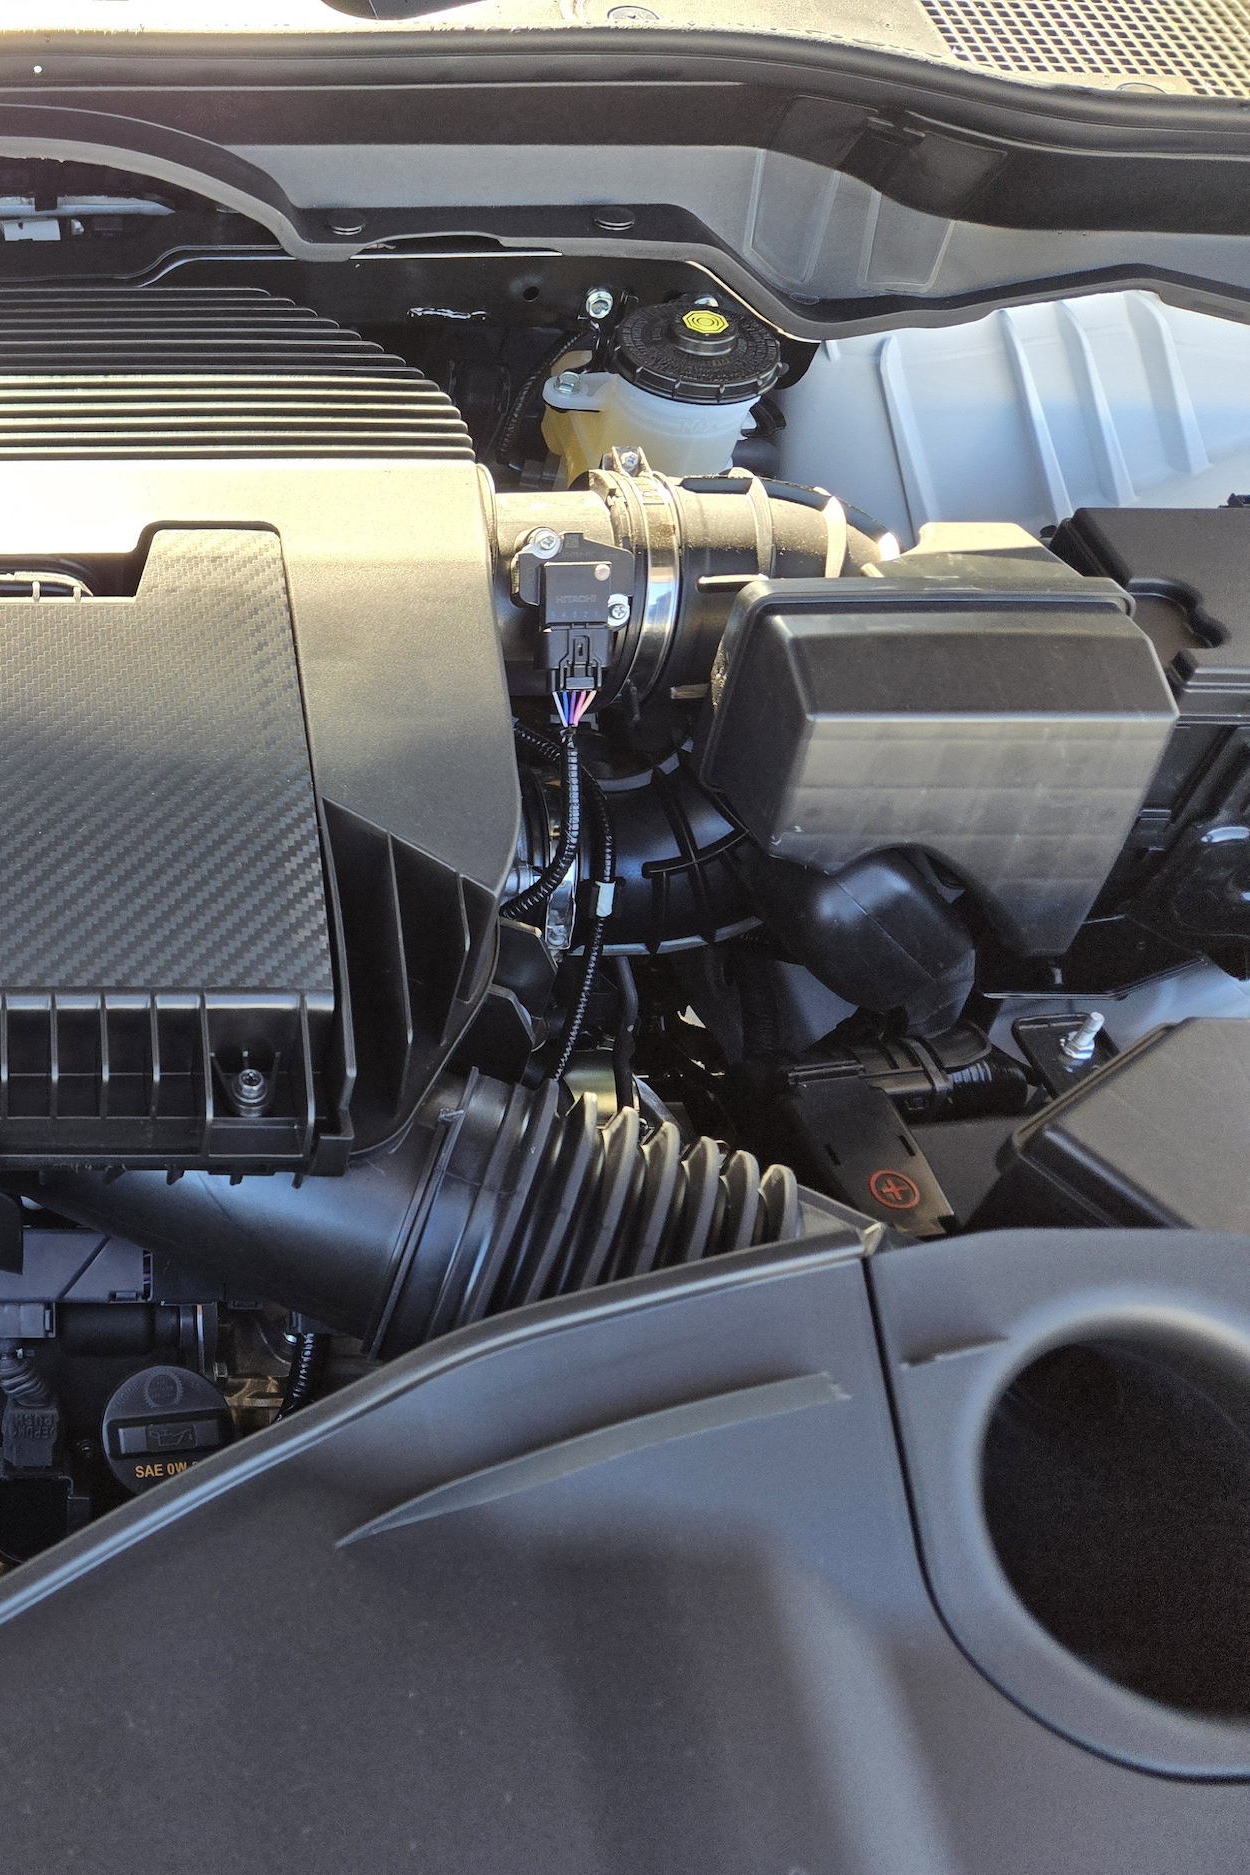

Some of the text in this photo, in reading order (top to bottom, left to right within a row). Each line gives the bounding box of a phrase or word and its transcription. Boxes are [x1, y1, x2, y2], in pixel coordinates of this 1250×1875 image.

[555, 594, 597, 604] HITACHI
[15, 1414, 53, 1426] PUSH
[135, 1463, 164, 1479] SAE
